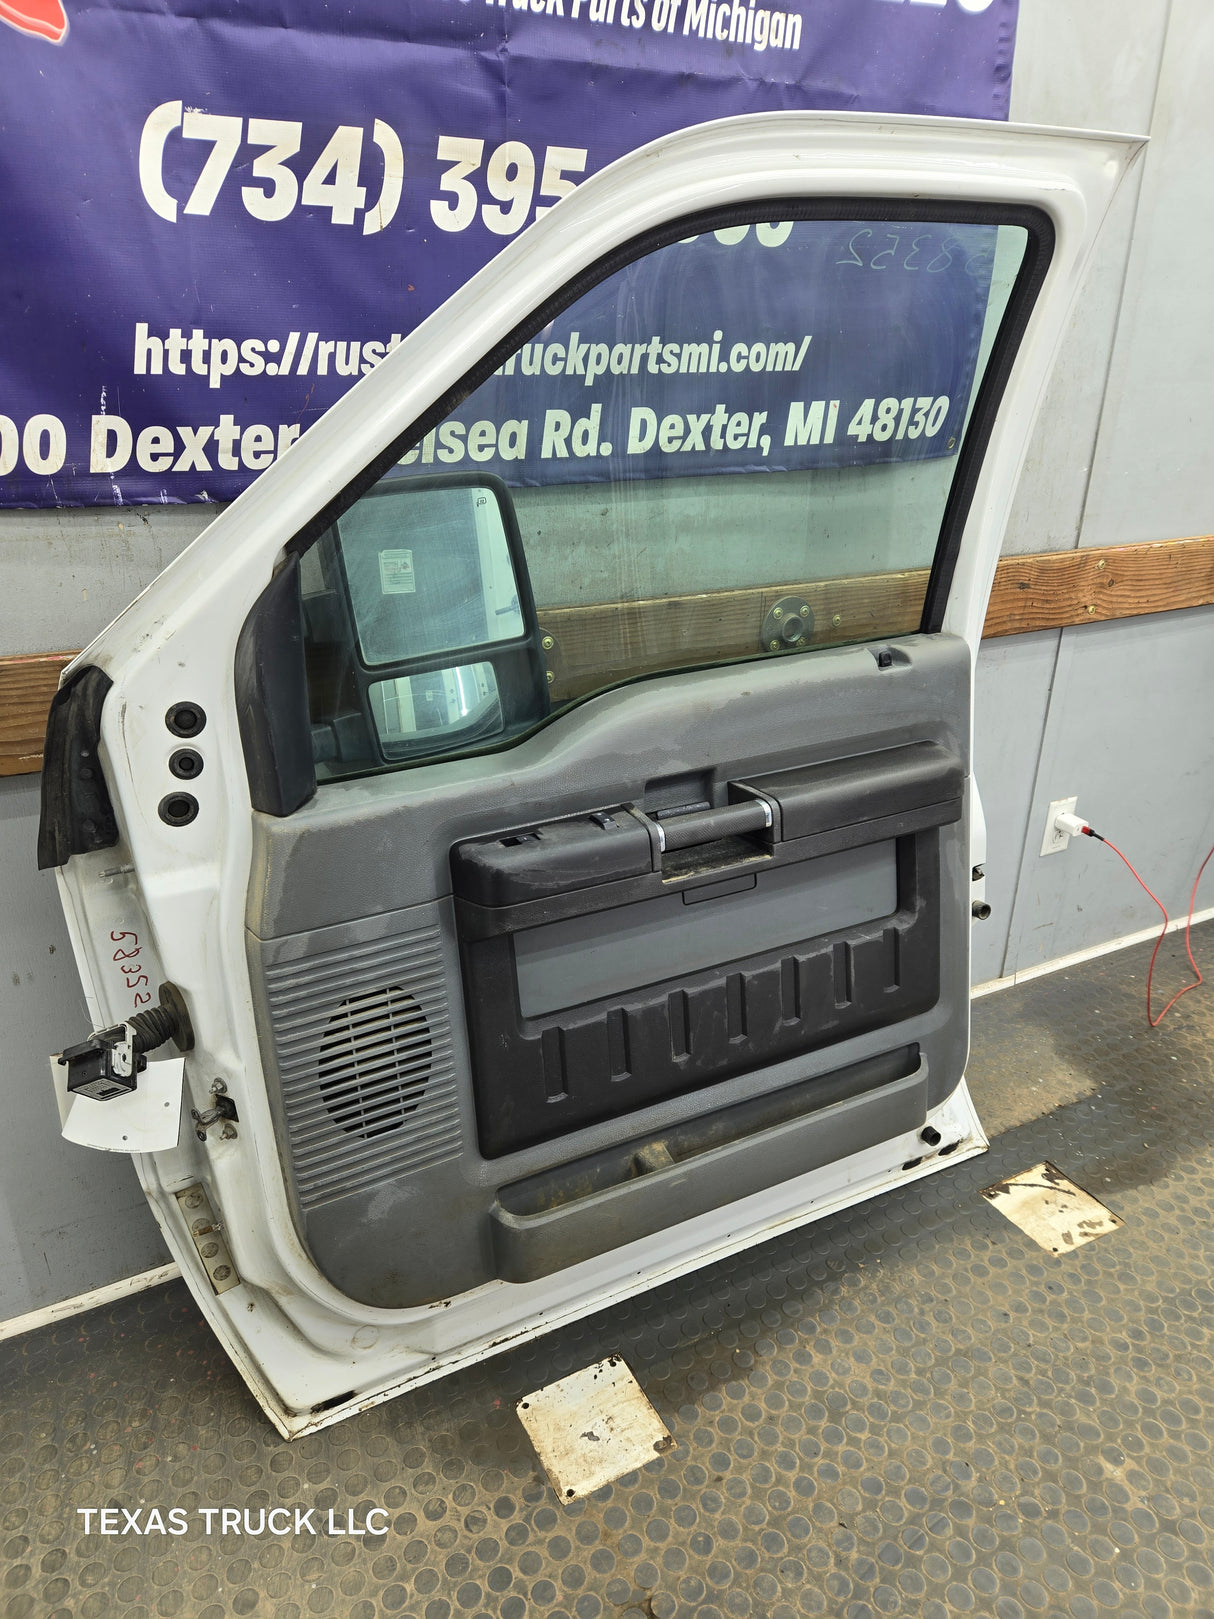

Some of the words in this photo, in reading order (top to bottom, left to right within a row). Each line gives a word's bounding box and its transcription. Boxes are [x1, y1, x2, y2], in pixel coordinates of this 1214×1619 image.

[651, 0, 682, 32] of
[682, 0, 802, 51] Michigan
[139, 100, 404, 236] (734)
[90, 414, 300, 473] Dexter
[541, 403, 613, 459] Rd.
[627, 403, 770, 456] Dexter,
[784, 400, 840, 446] MI
[847, 395, 950, 442] 48130
[110, 931, 152, 1008] 58352
